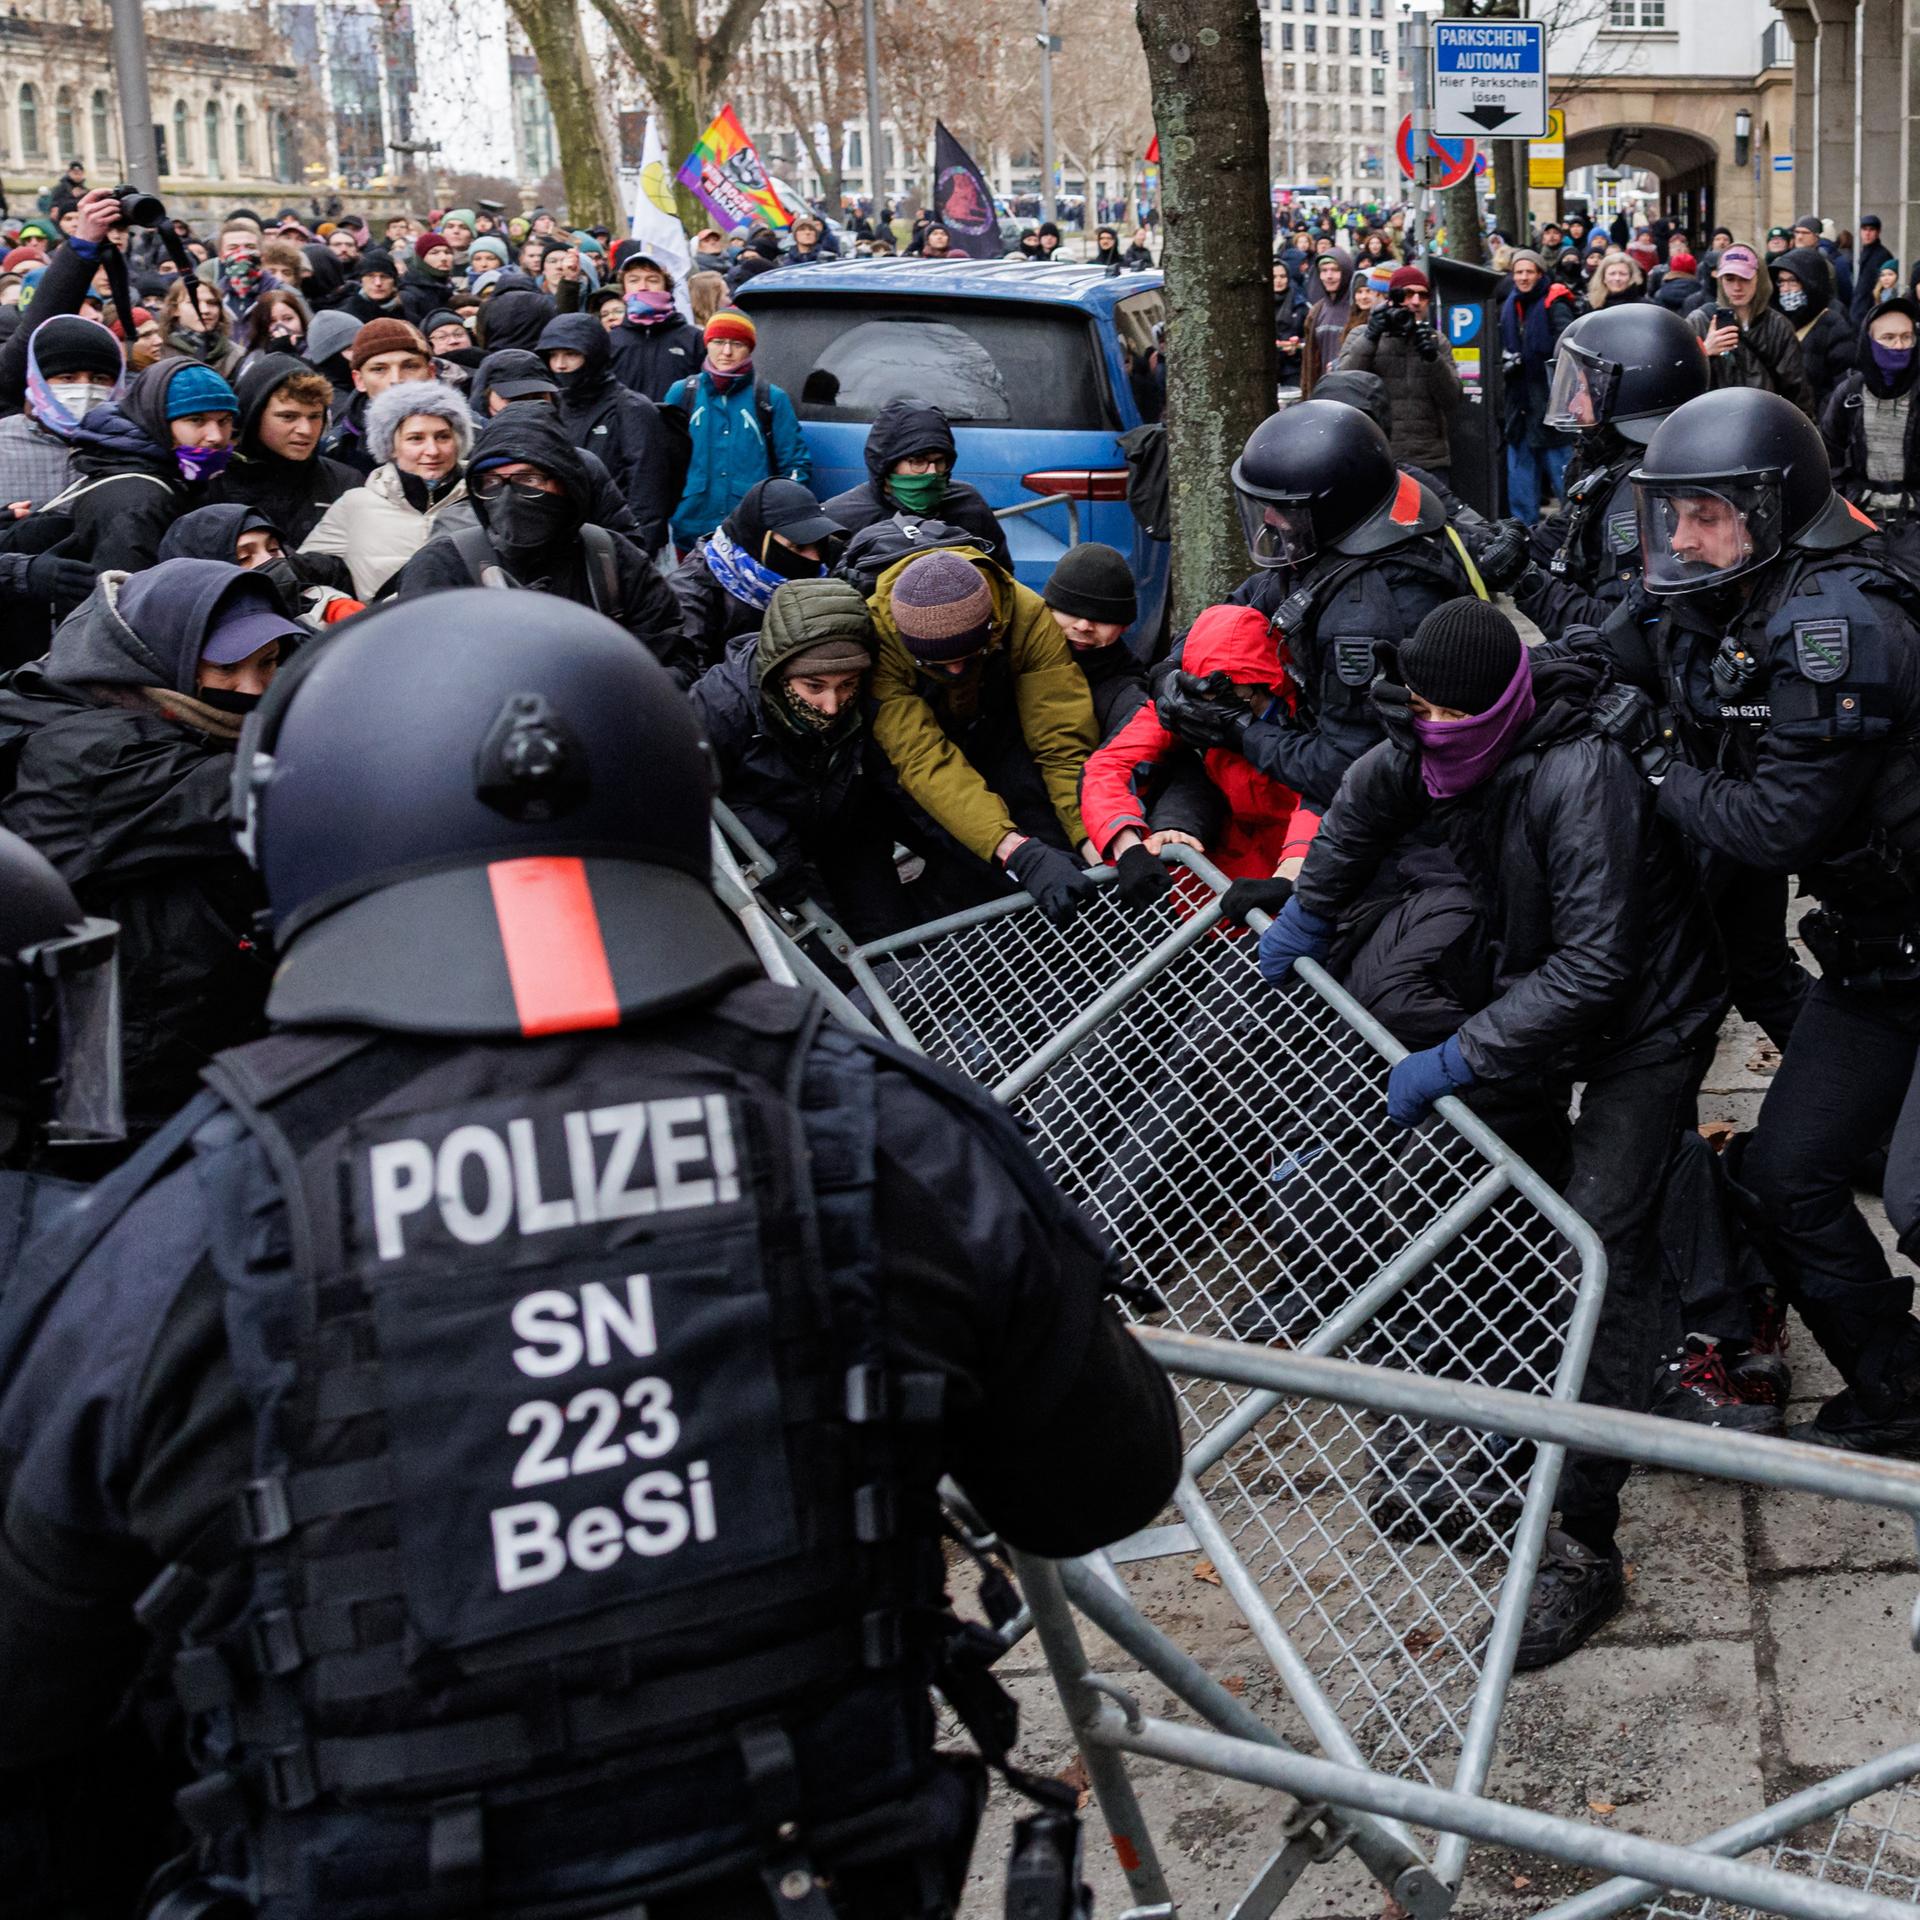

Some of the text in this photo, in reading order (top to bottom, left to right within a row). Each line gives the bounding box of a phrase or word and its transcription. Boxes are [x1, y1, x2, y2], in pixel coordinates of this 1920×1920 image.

[1440, 28, 1537, 47] PARKSCHEIN-
[1456, 52, 1522, 70] AUTOMAT
[1439, 76, 1539, 89] Hier Parkschein
[1472, 92, 1506, 103] lösen
[1453, 308, 1473, 337] P
[1720, 706, 1739, 717] SN
[511, 1273, 656, 1378] SN
[507, 1376, 680, 1488] 223
[490, 1458, 717, 1592] BeSi
